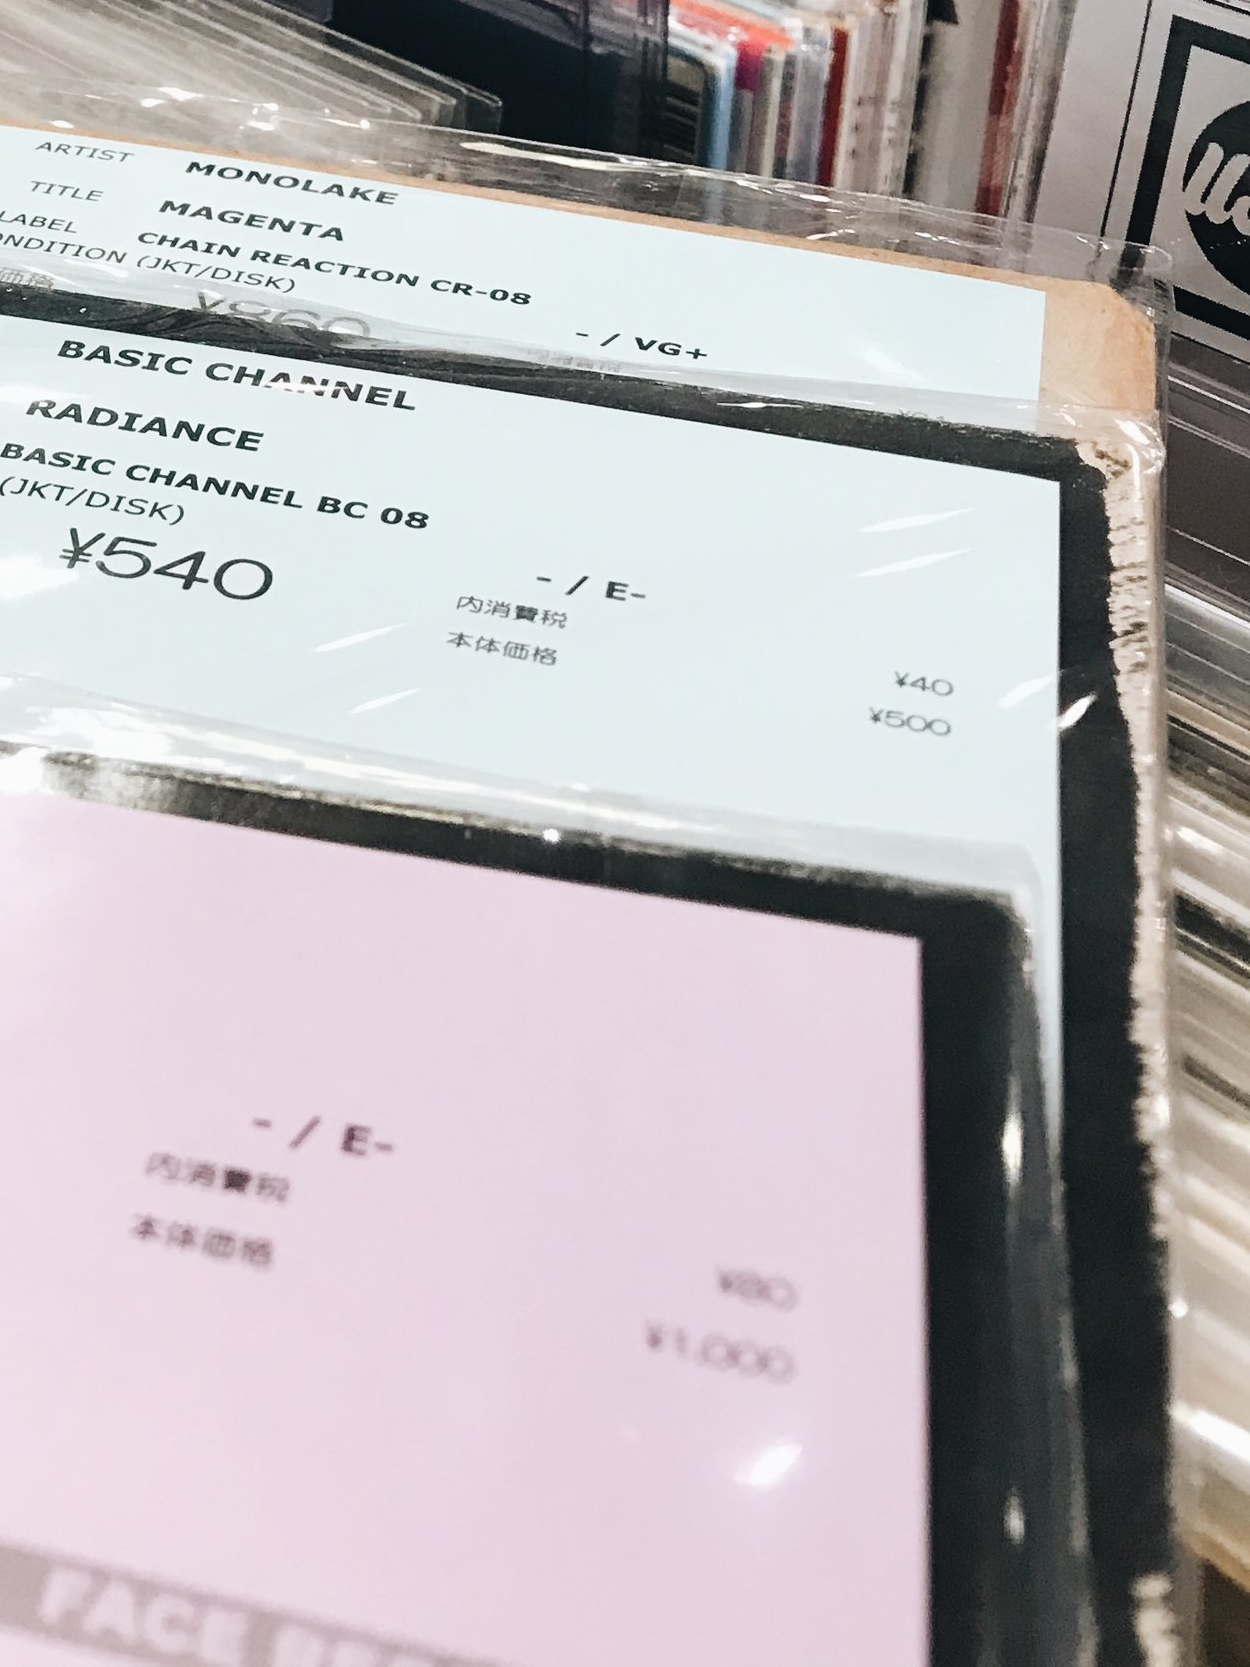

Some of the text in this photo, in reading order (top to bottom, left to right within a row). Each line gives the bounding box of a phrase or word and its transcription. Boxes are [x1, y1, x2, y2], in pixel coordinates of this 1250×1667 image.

[35, 140, 399, 207] ARTIST MONOLAKE
[29, 180, 345, 242] TITLE MAGENTA
[137, 231, 245, 259] CHAIN
[250, 250, 420, 287] REACTION
[430, 279, 532, 306] CR-08
[136, 255, 297, 294] (JKT/DISK)
[600, 333, 620, 346] /
[635, 337, 708, 360] VG+
[56, 339, 192, 376] BASIC
[204, 362, 417, 412] CHANNEL
[25, 399, 265, 454] RADIANCE
[133, 464, 303, 510] CHANNEL
[316, 496, 367, 517] BC
[380, 507, 429, 530] 08
[59, 527, 274, 601] ¥540
[566, 575, 588, 595] /
[605, 581, 646, 602] E-
[456, 595, 954, 697] 内消費税 ¥40
[446, 631, 952, 737] 本体価格 ¥500
[289, 1116, 321, 1149] /
[341, 1124, 393, 1156] E-
[40, 1566, 248, 1667] FACE
